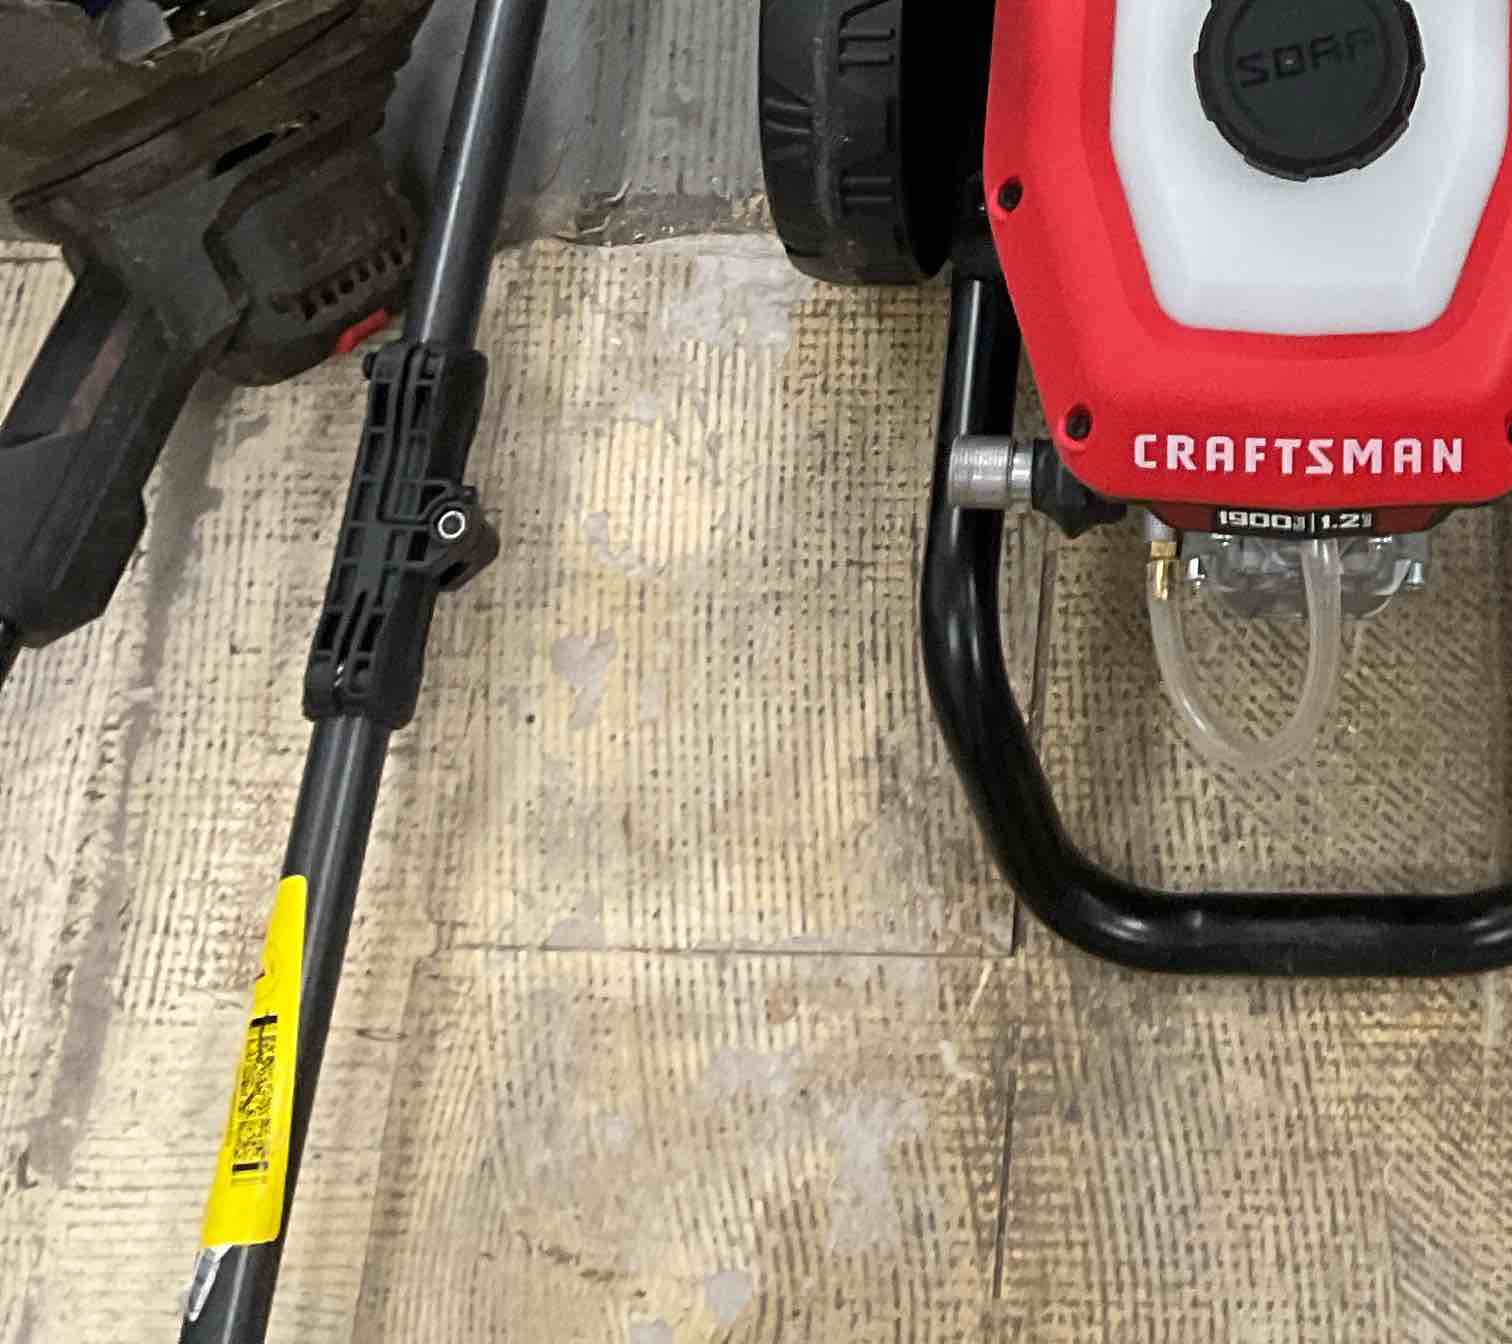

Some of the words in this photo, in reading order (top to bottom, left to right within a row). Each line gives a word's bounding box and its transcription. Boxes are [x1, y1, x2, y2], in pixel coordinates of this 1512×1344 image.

[1236, 26, 1376, 90] SOAP
[1133, 432, 1465, 476] CRAFTSMAN
[1218, 509, 1292, 530] 1900
[1319, 512, 1361, 530] 1.2
